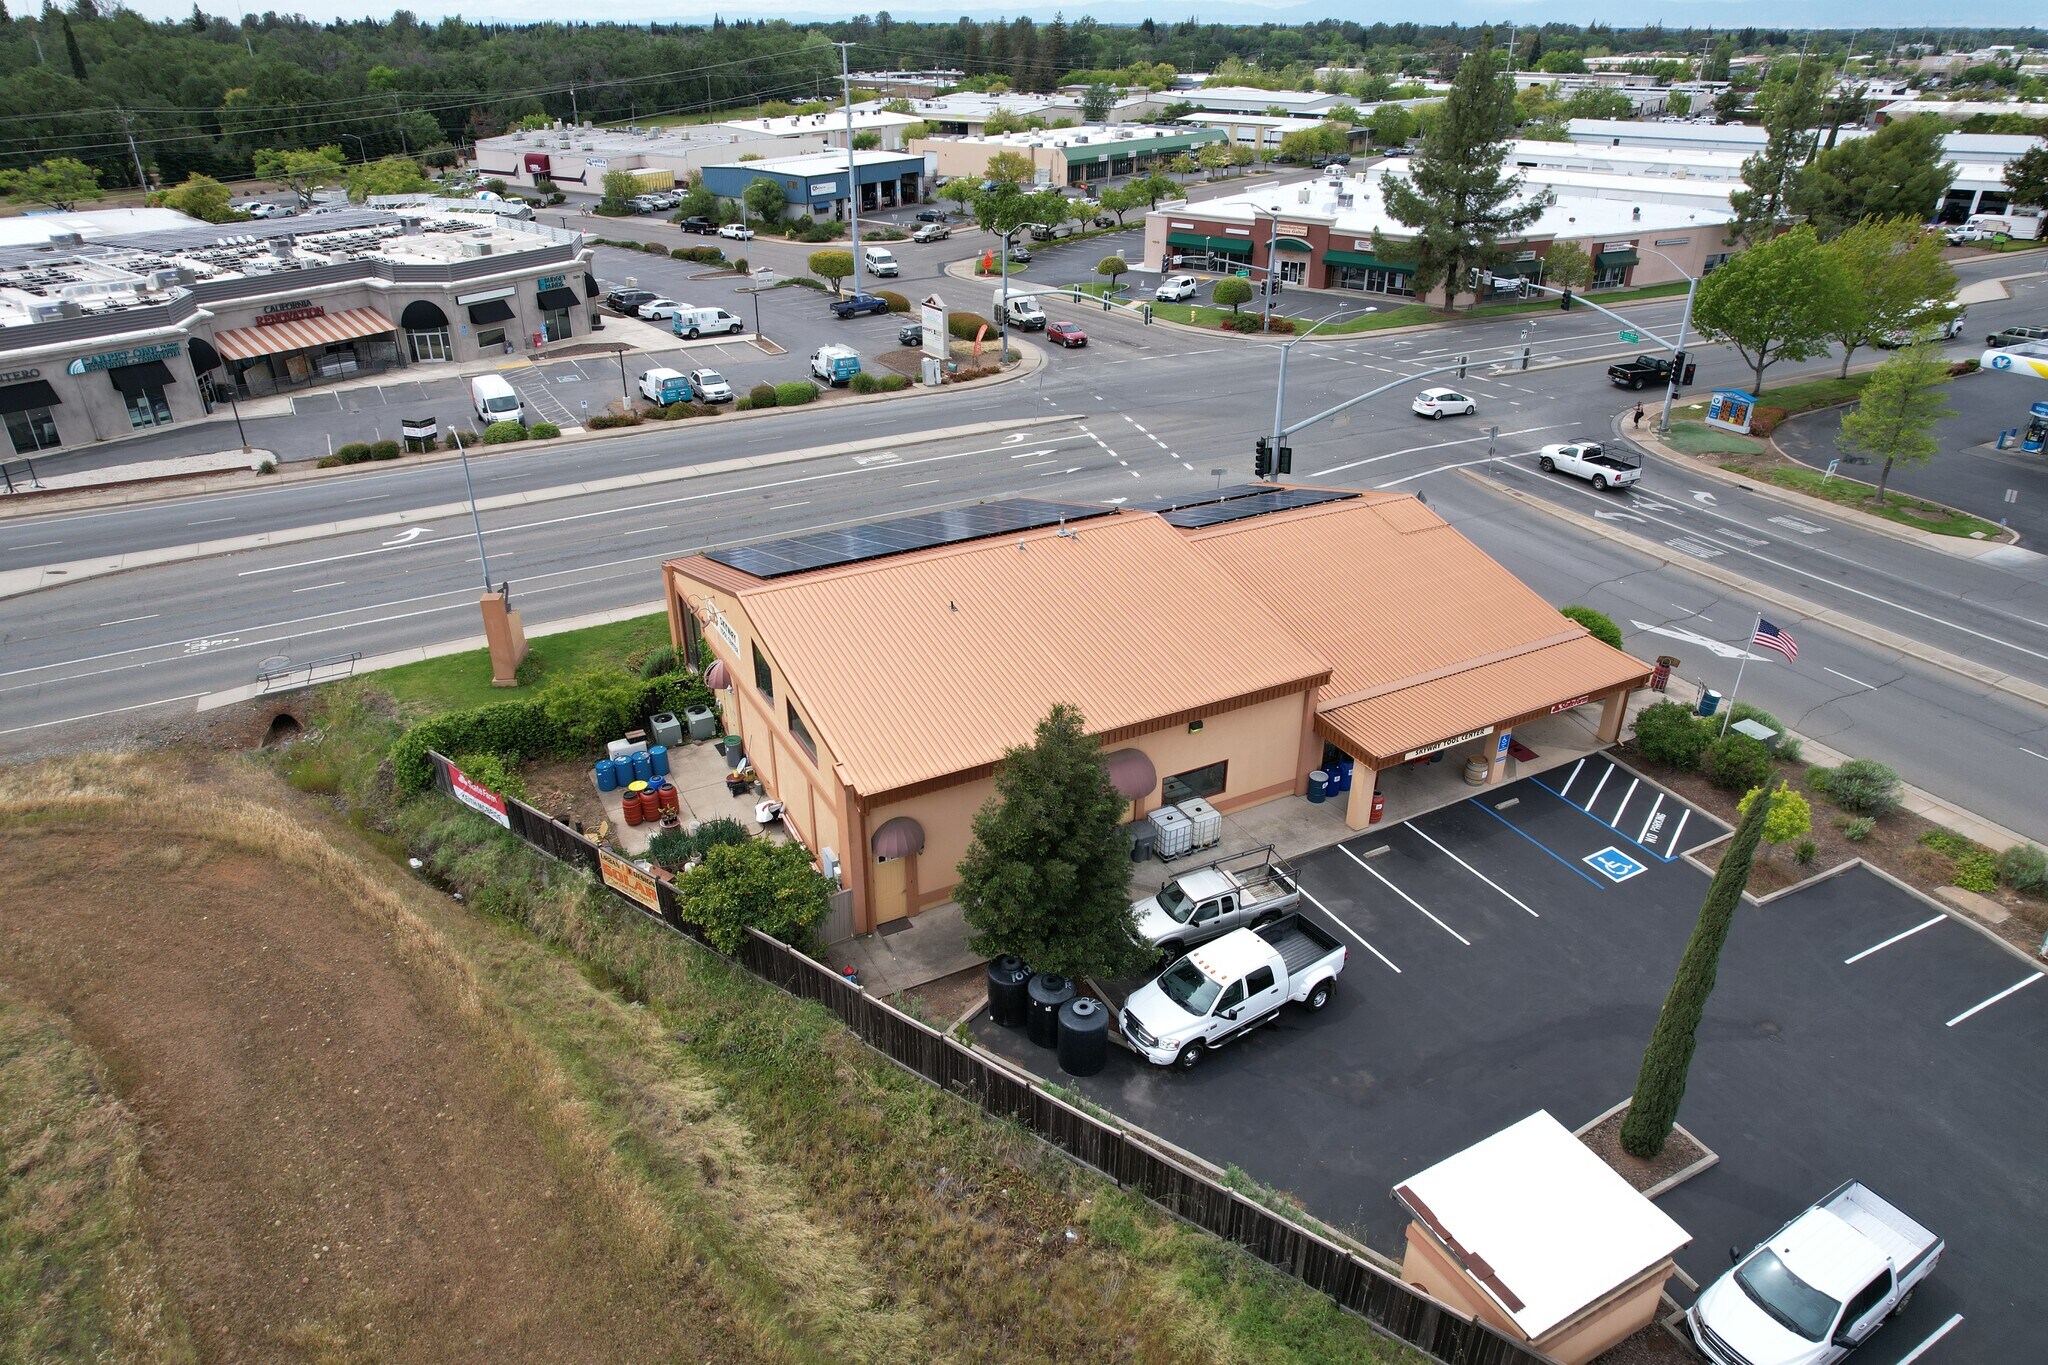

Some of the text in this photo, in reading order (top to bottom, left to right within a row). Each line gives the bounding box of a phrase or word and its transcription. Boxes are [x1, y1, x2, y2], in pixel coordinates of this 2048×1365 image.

[255, 306, 325, 327] RENOVATION
[264, 299, 312, 314] CALIFORNIA
[81, 350, 130, 366] CARPET
[1415, 729, 1485, 756] SKYWAY TOOL CENTER
[1644, 812, 1667, 844] NO PARKING
[602, 863, 658, 902] SOLAR
